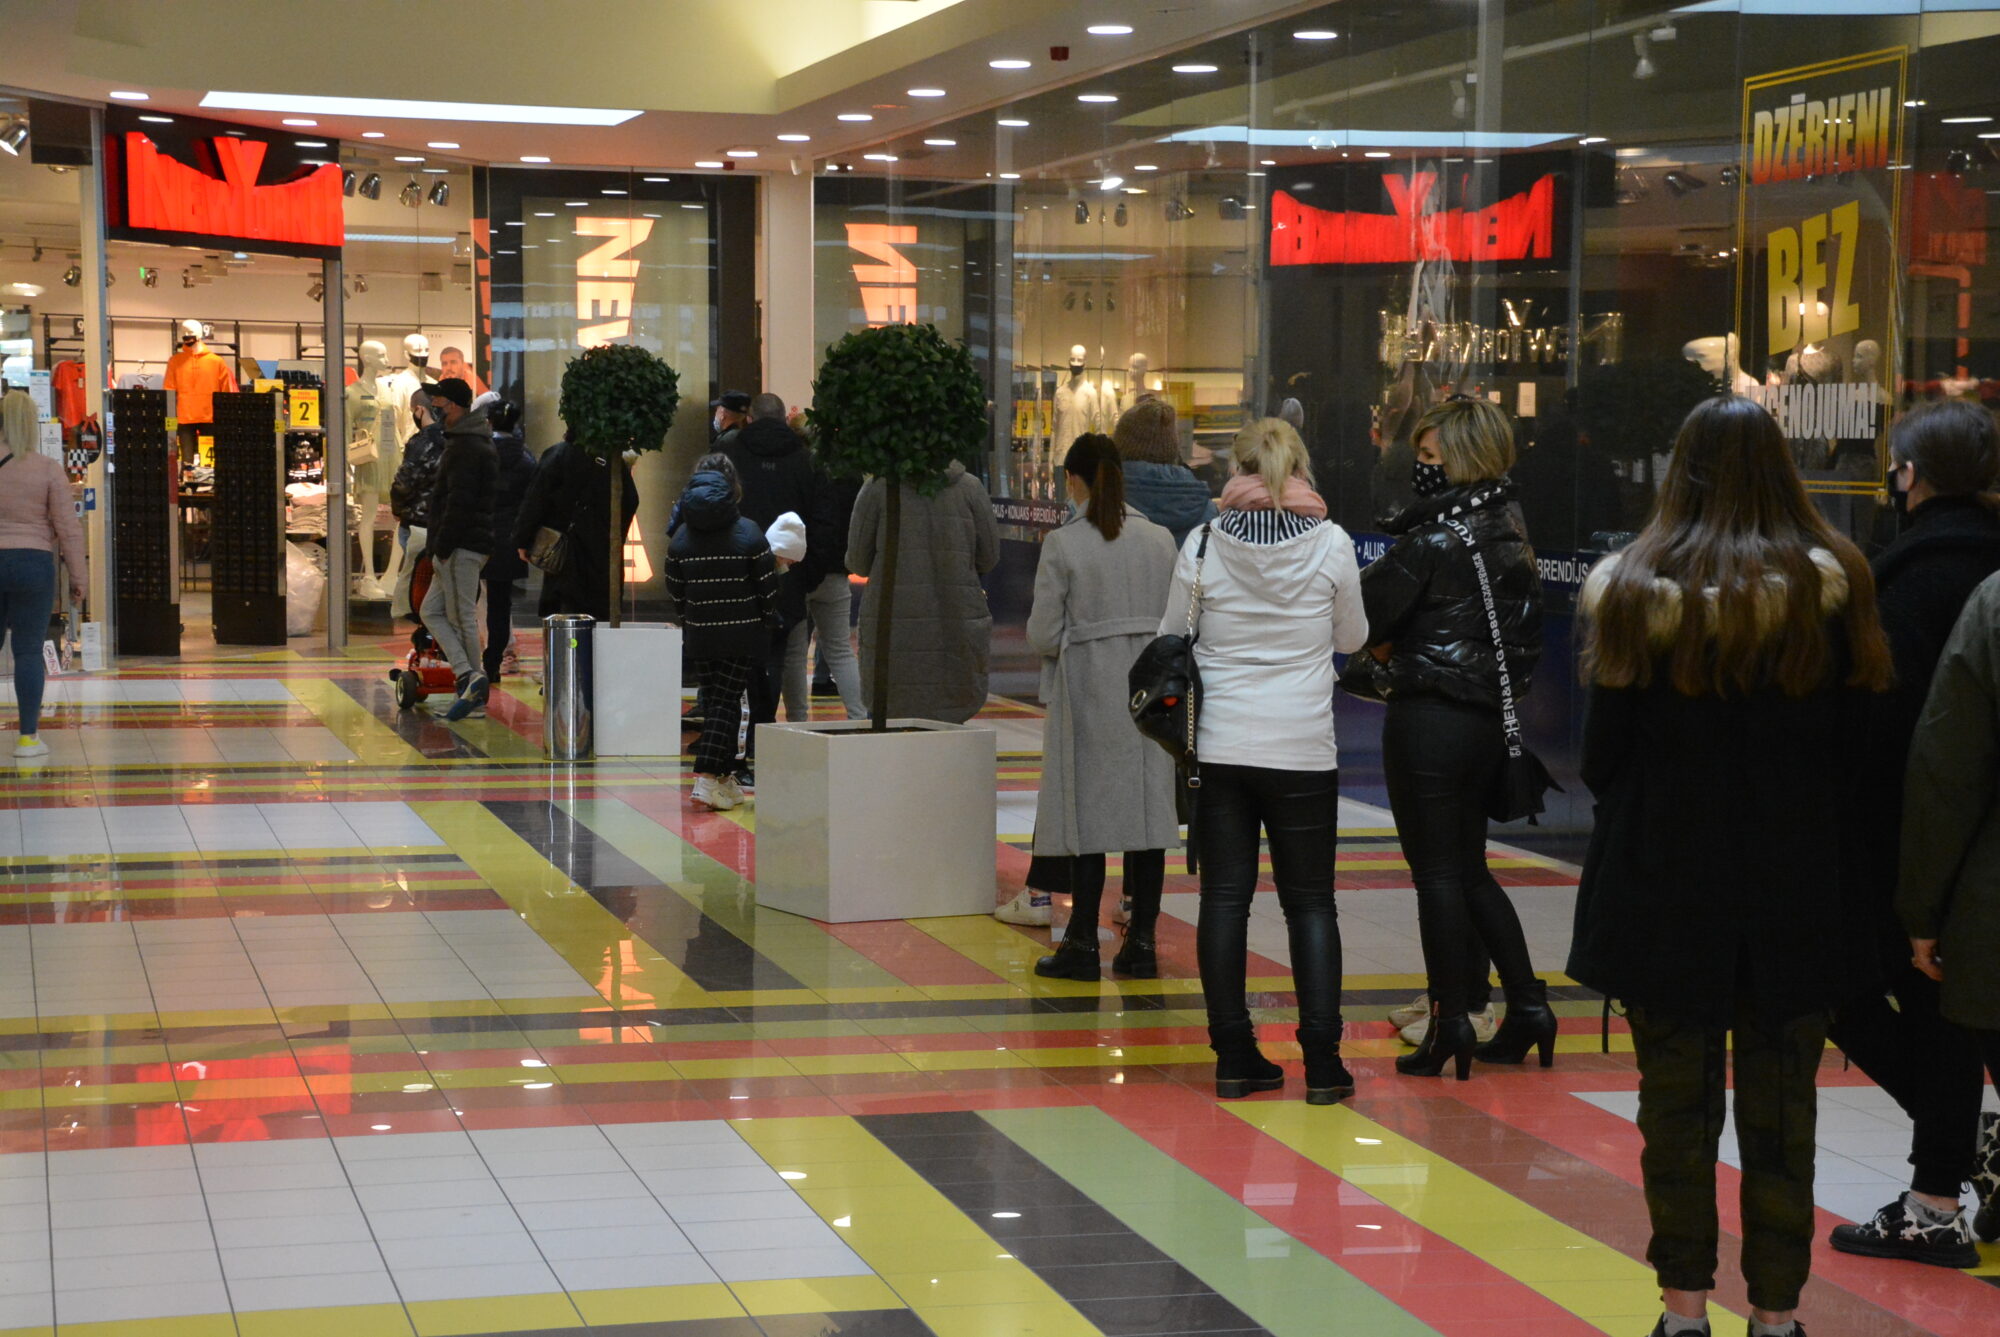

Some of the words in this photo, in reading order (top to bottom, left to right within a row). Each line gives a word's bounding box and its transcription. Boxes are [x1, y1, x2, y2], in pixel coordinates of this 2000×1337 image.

[1752, 87, 1891, 184] DZĒRIENI
[1767, 200, 1860, 356] BEZ
[299, 401, 310, 421] 2
[1744, 382, 1878, 440] CENOJUMA!
[1363, 541, 1385, 560] ALUS
